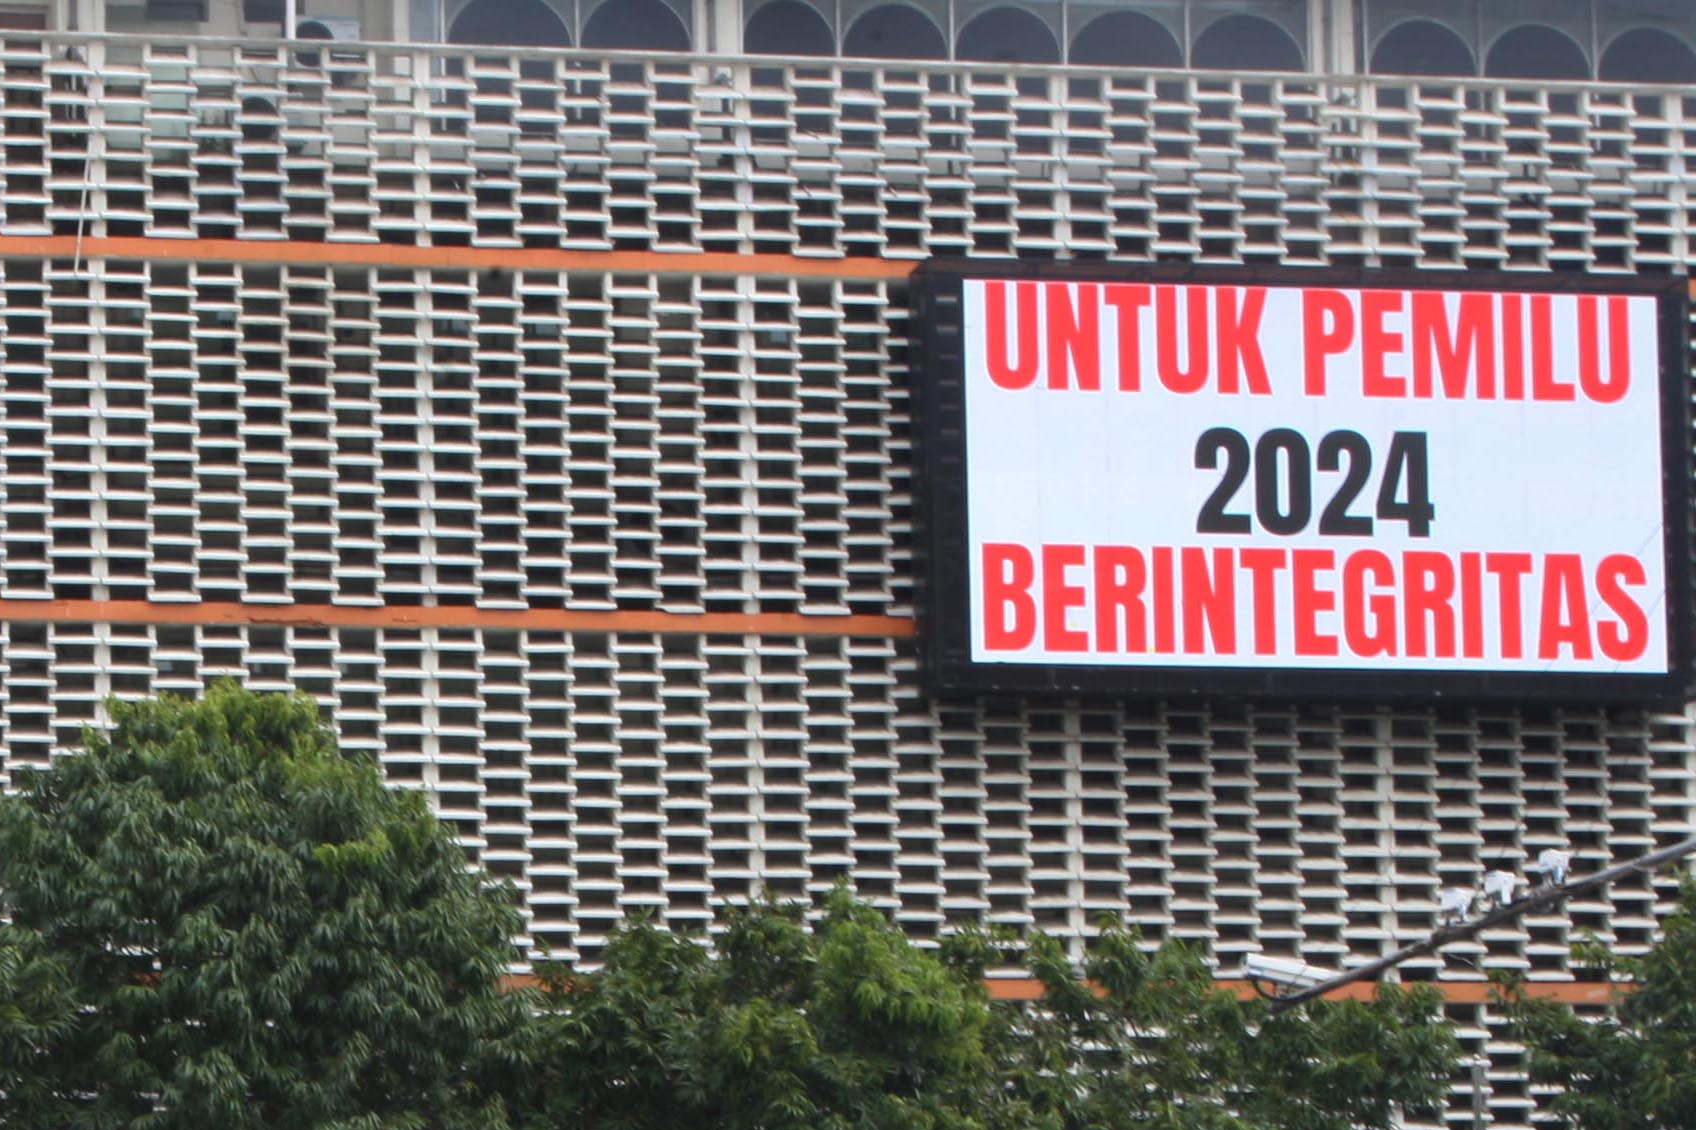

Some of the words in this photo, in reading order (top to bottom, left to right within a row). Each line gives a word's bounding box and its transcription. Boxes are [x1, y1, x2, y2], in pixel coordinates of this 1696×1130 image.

[984, 281, 1272, 396] UNTUK
[1302, 288, 1631, 404] PEMILU
[1194, 427, 1435, 538] 2024
[981, 542, 1650, 663] BERINTEGRITAS
